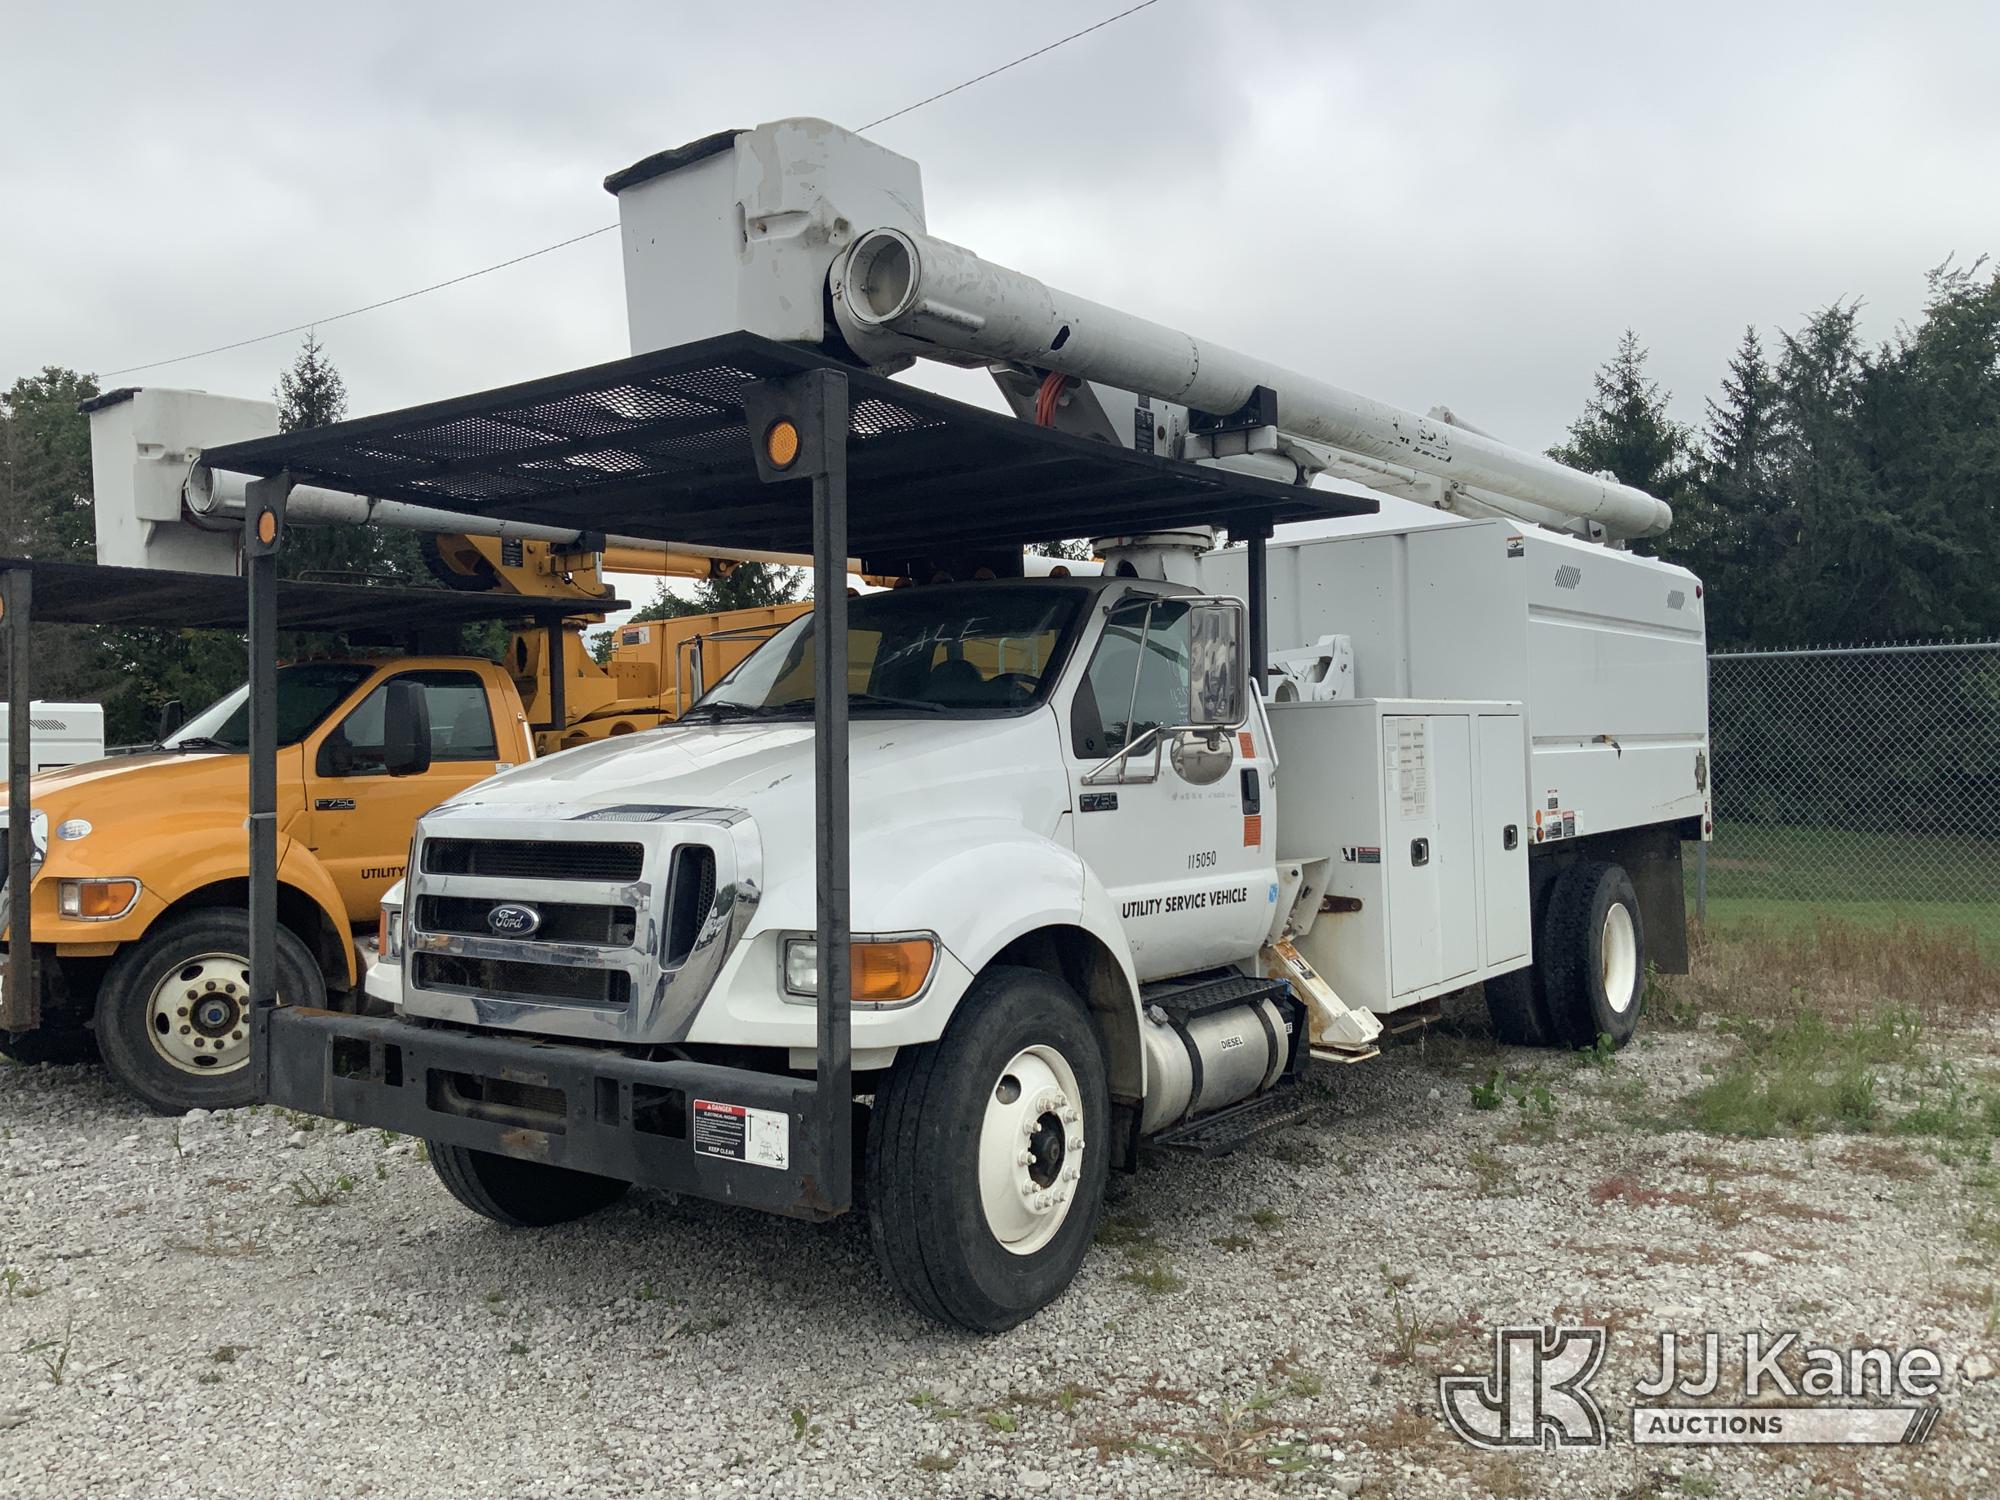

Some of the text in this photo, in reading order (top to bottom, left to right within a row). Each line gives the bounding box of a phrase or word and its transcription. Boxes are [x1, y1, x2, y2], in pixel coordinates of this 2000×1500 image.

[1187, 850, 1217, 870] 115050
[360, 866, 405, 879] UTILITY
[1122, 887, 1248, 919] UTILITY SERVICE VEHICLE
[495, 909, 525, 929] Ford
[1221, 1036, 1243, 1049] DIESEL
[711, 1104, 732, 1112] DANGER
[720, 1148, 734, 1156] CLEAR
